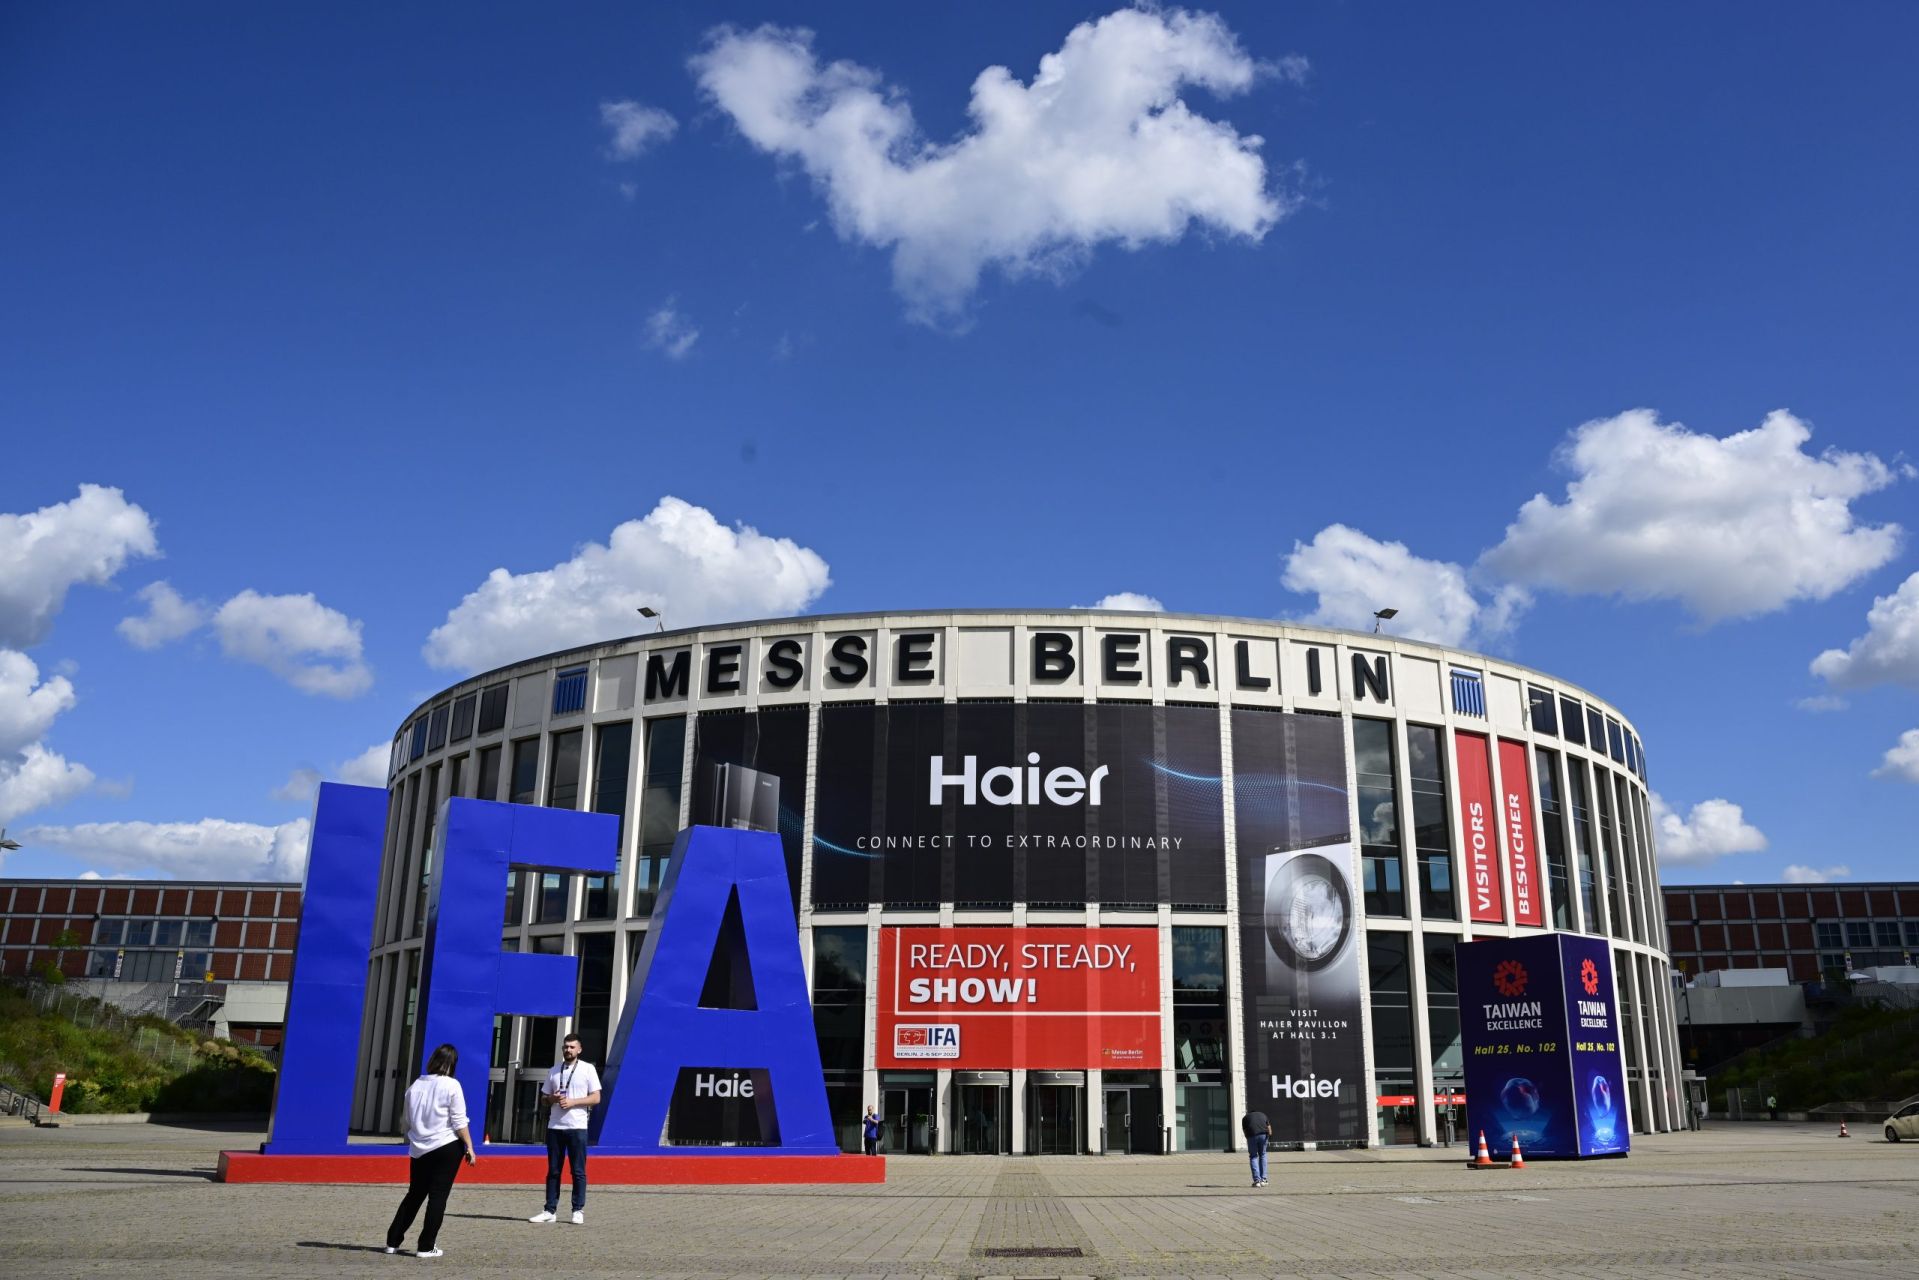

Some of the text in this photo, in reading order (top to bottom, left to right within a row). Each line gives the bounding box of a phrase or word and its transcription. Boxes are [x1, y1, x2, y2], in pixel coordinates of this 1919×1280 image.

[644, 632, 1390, 701] MESSE BERLIN
[929, 751, 1109, 806] Haier
[856, 835, 1184, 851] CONNECT TO EXTRAORDINARY
[1469, 802, 1492, 912] VISITORS
[1508, 793, 1531, 915] BESUCHER
[266, 780, 838, 1150] IFA
[910, 943, 1136, 973] READY, STEADY,
[909, 977, 1038, 1004] SHOW!
[1290, 1009, 1318, 1017] VISIT
[1483, 1001, 1542, 1019] TAIWAN
[1577, 1000, 1607, 1017] TAIWAN
[1260, 1020, 1348, 1028] HAIER PAVILLON
[1487, 1018, 1543, 1031] EXCELLENCE
[1580, 1017, 1608, 1029] EXCELLENCE
[928, 1027, 957, 1046] IFA
[1272, 1031, 1337, 1039] AT HALL 3.1
[1475, 1045, 1494, 1055] Hall
[1516, 1043, 1534, 1053] No.
[1538, 1042, 1556, 1052] 102
[1576, 1042, 1587, 1051] Hall
[1596, 1042, 1605, 1051] No.
[1606, 1042, 1615, 1052] 102
[695, 1073, 755, 1098] Haie
[1271, 1073, 1342, 1098] Haier
